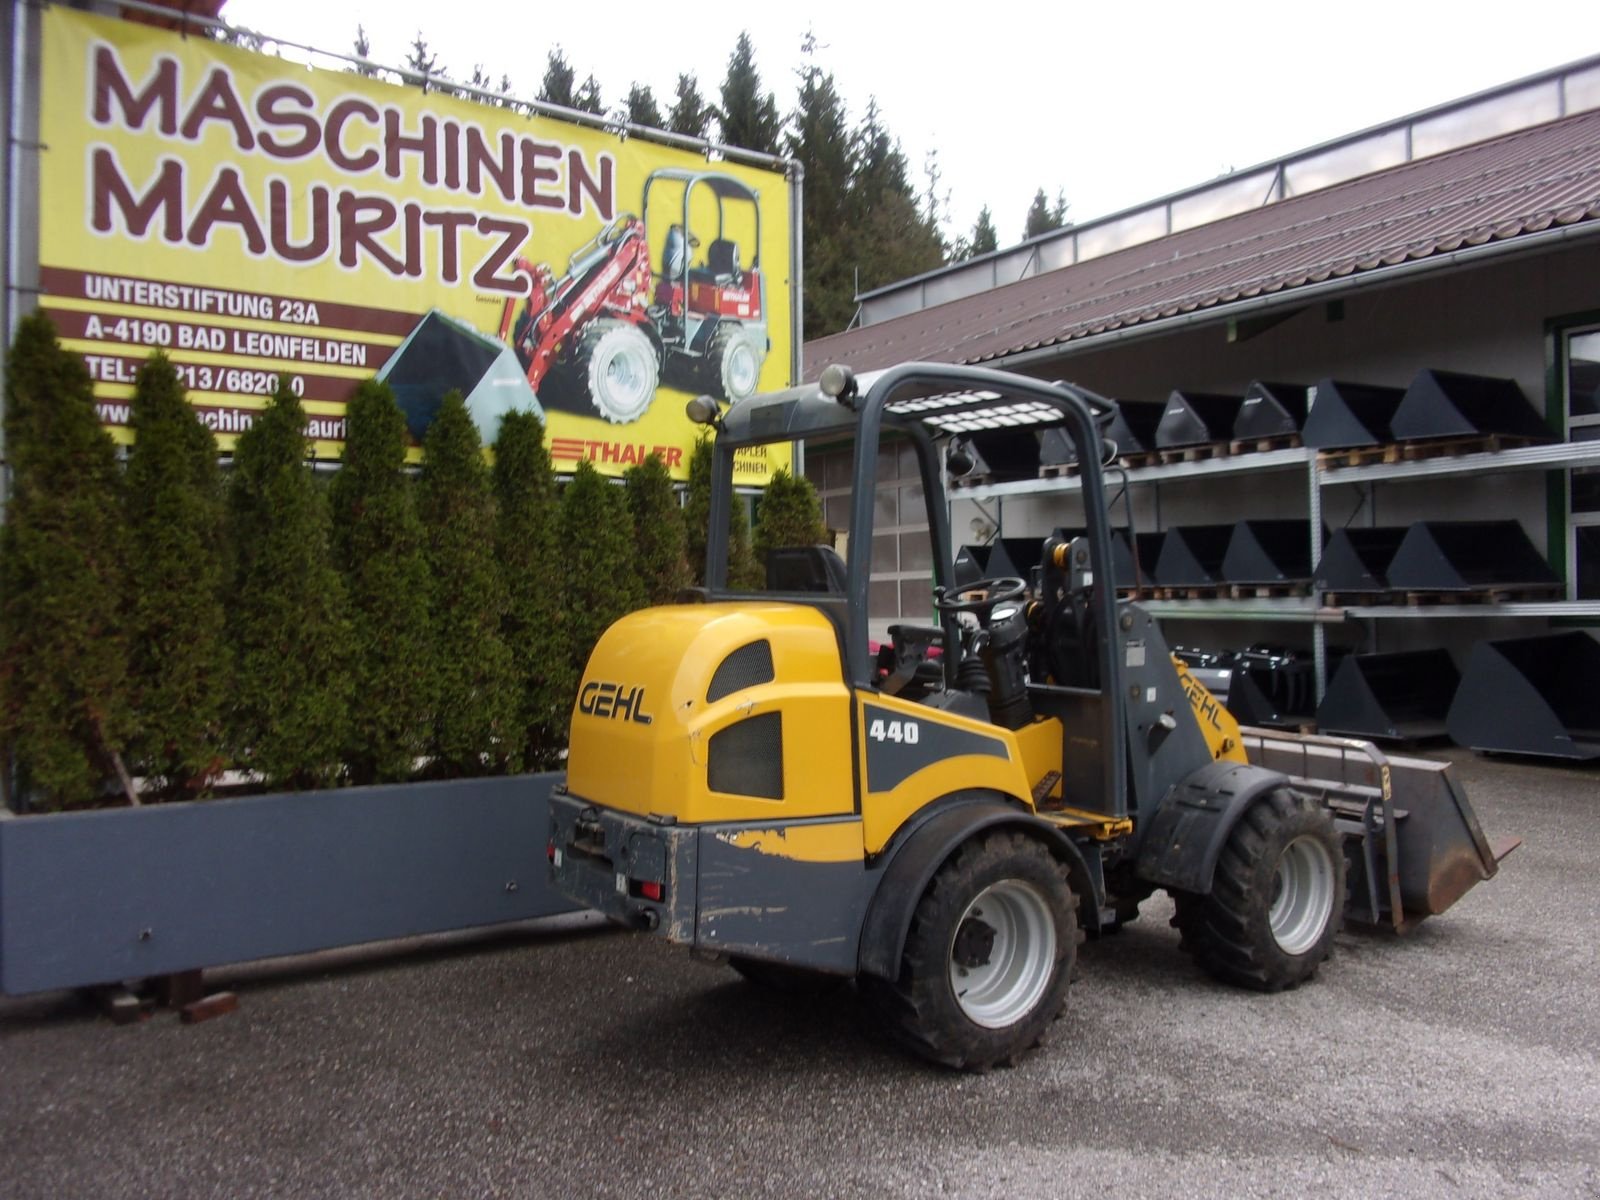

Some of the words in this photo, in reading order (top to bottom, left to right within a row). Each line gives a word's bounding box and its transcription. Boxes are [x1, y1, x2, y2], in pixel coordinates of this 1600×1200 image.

[92, 45, 614, 221] MASCHINEN
[91, 147, 530, 294] MAURITZ
[84, 273, 274, 320] UNTERSTIFTUNG
[279, 299, 320, 325] 23A
[84, 314, 172, 346] A-4190
[177, 324, 227, 352] BAD
[233, 330, 366, 366] LEONFELDEN
[84, 355, 137, 384] TEL:
[585, 439, 683, 468] THALER
[578, 681, 653, 725] GEHL
[869, 719, 919, 744] 440
